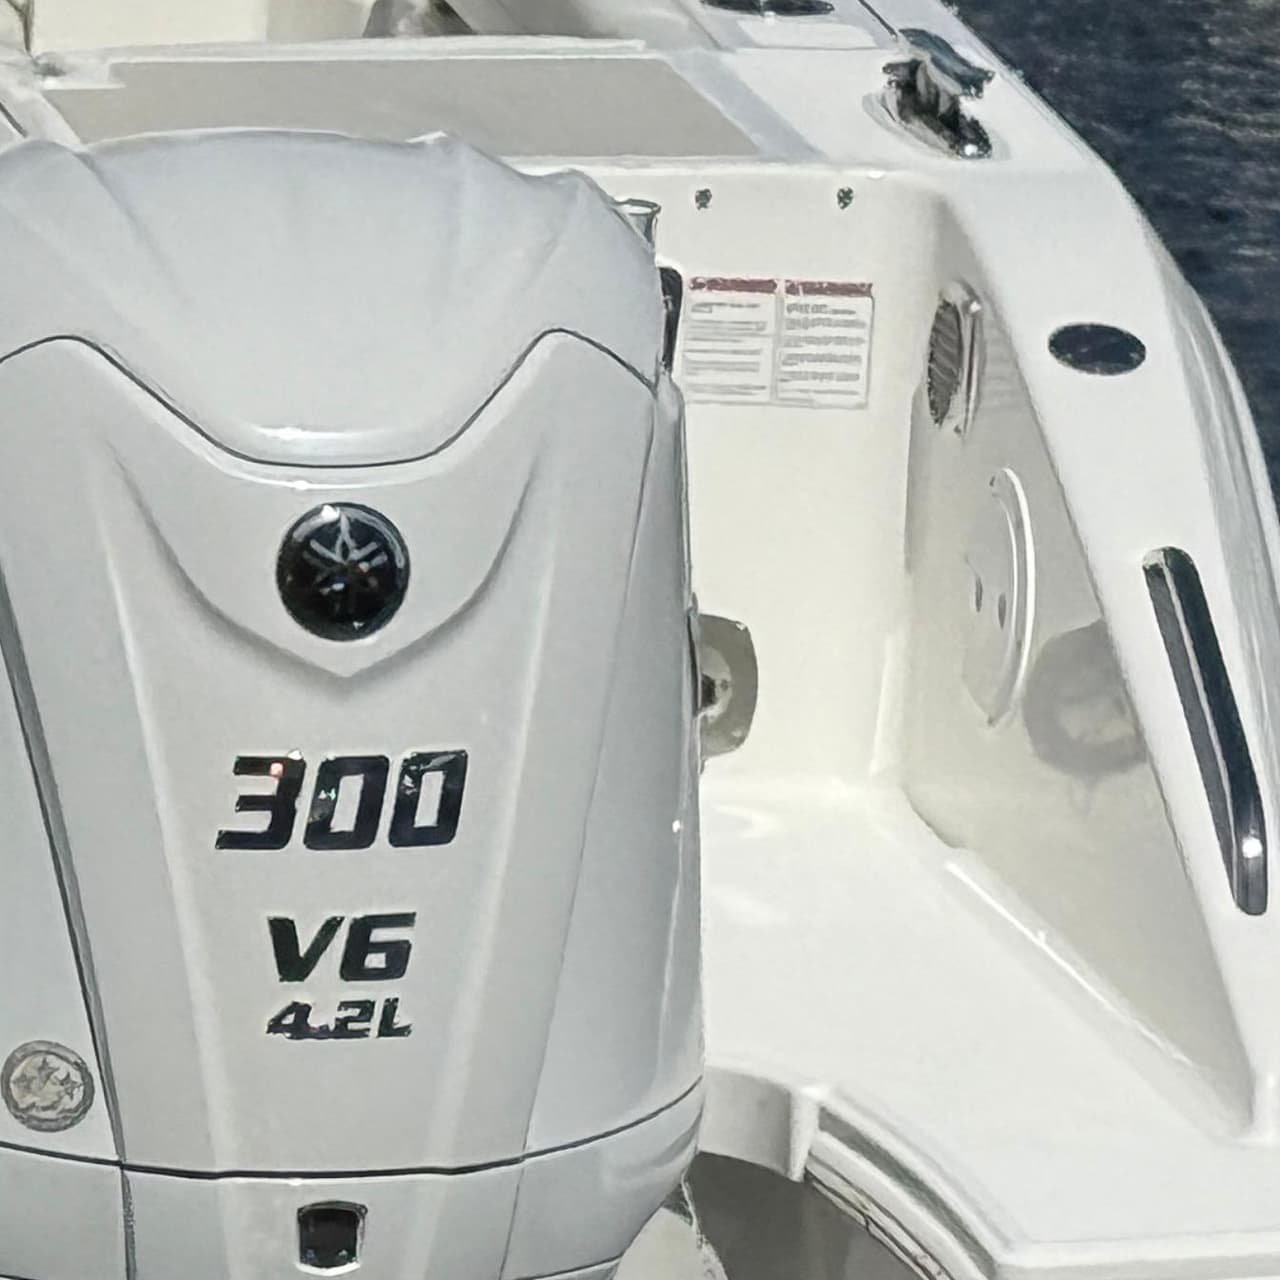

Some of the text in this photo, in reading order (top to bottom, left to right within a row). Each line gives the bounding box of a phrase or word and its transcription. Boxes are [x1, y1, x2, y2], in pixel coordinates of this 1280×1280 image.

[215, 749, 468, 850] 300
[267, 912, 417, 982] V6
[266, 998, 413, 1039] 4.2L
